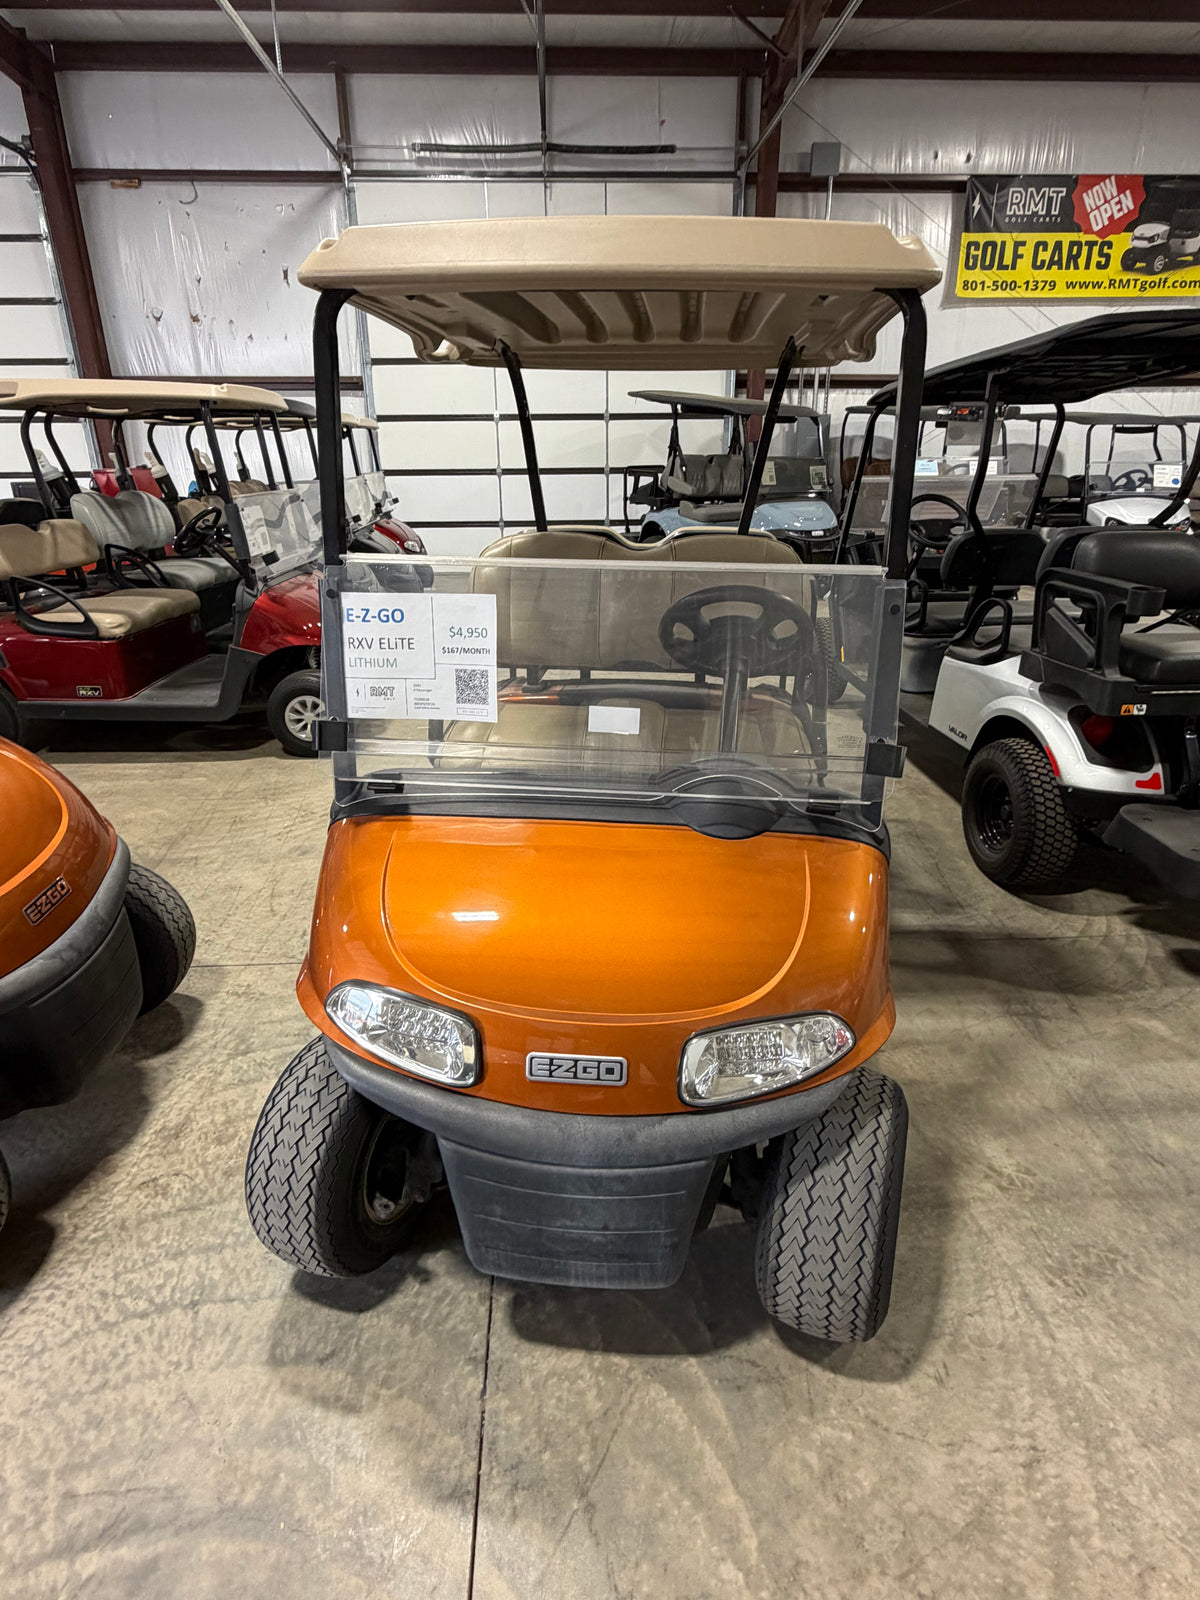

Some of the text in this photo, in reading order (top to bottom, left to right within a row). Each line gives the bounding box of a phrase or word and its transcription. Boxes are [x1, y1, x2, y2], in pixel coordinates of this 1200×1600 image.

[1006, 187, 1067, 216] RMT
[1082, 175, 1118, 212] NOW
[1088, 189, 1135, 232] OPEN
[963, 240, 1114, 271] GOLF CARTS
[962, 277, 1200, 293] 801-500-1379 www.RMTgolf.com
[346, 608, 405, 623] E-Z-GO
[449, 626, 488, 639] $4,950
[348, 637, 373, 650] RXV
[442, 646, 491, 655] $167/MONTH
[349, 658, 398, 668] LITHIUM
[370, 686, 395, 697] RMT
[26, 880, 69, 922] EZGO
[531, 1058, 621, 1080] EZGO
